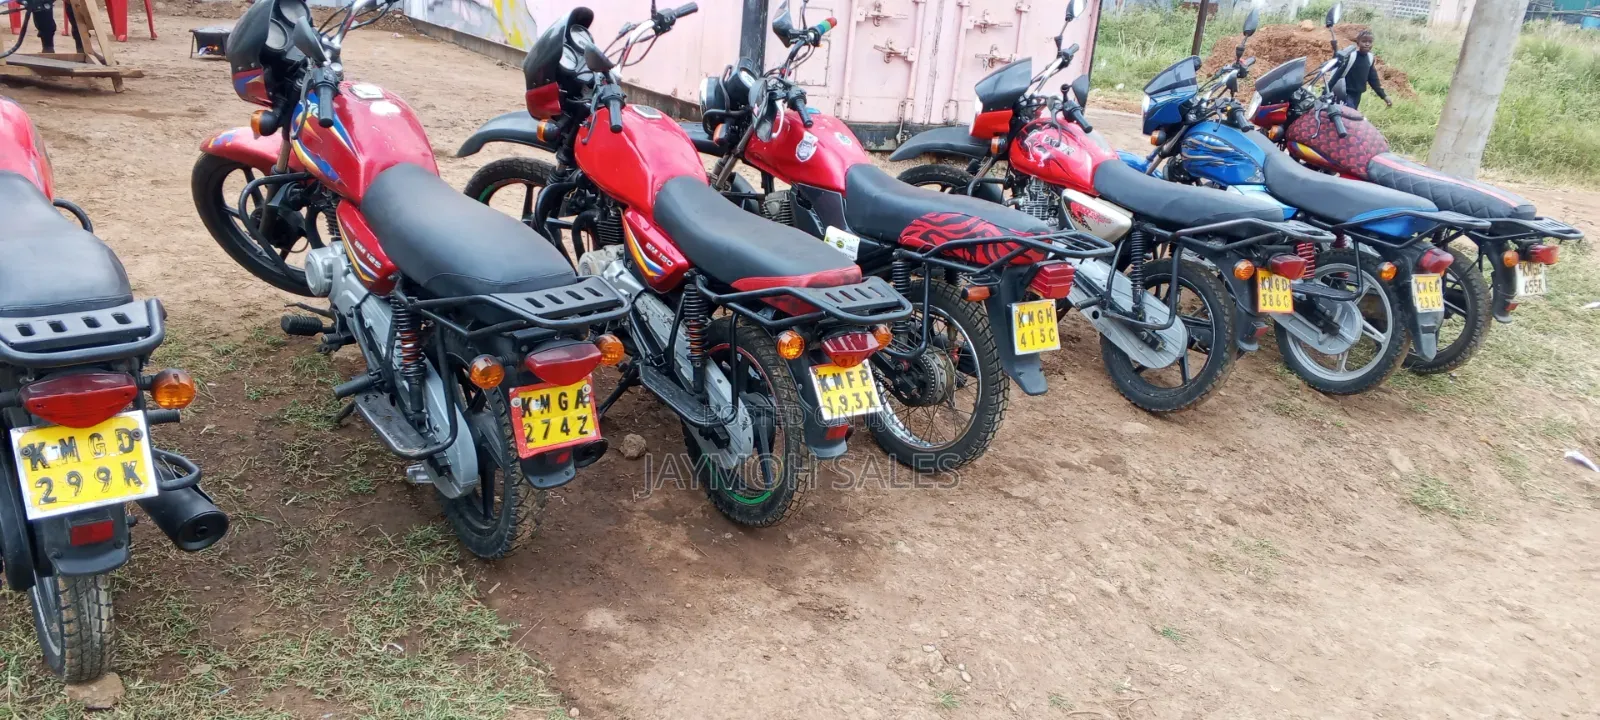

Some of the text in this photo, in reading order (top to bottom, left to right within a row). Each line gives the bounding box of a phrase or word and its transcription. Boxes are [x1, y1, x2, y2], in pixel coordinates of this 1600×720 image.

[1018, 307, 1054, 329] KMGH
[1020, 328, 1056, 348] 415C
[818, 369, 870, 393] KMFP
[521, 389, 589, 418] KMGA
[826, 391, 876, 414] 193X
[524, 415, 589, 443] 274Z
[29, 427, 136, 472] KMGD
[34, 460, 143, 505] 299K
